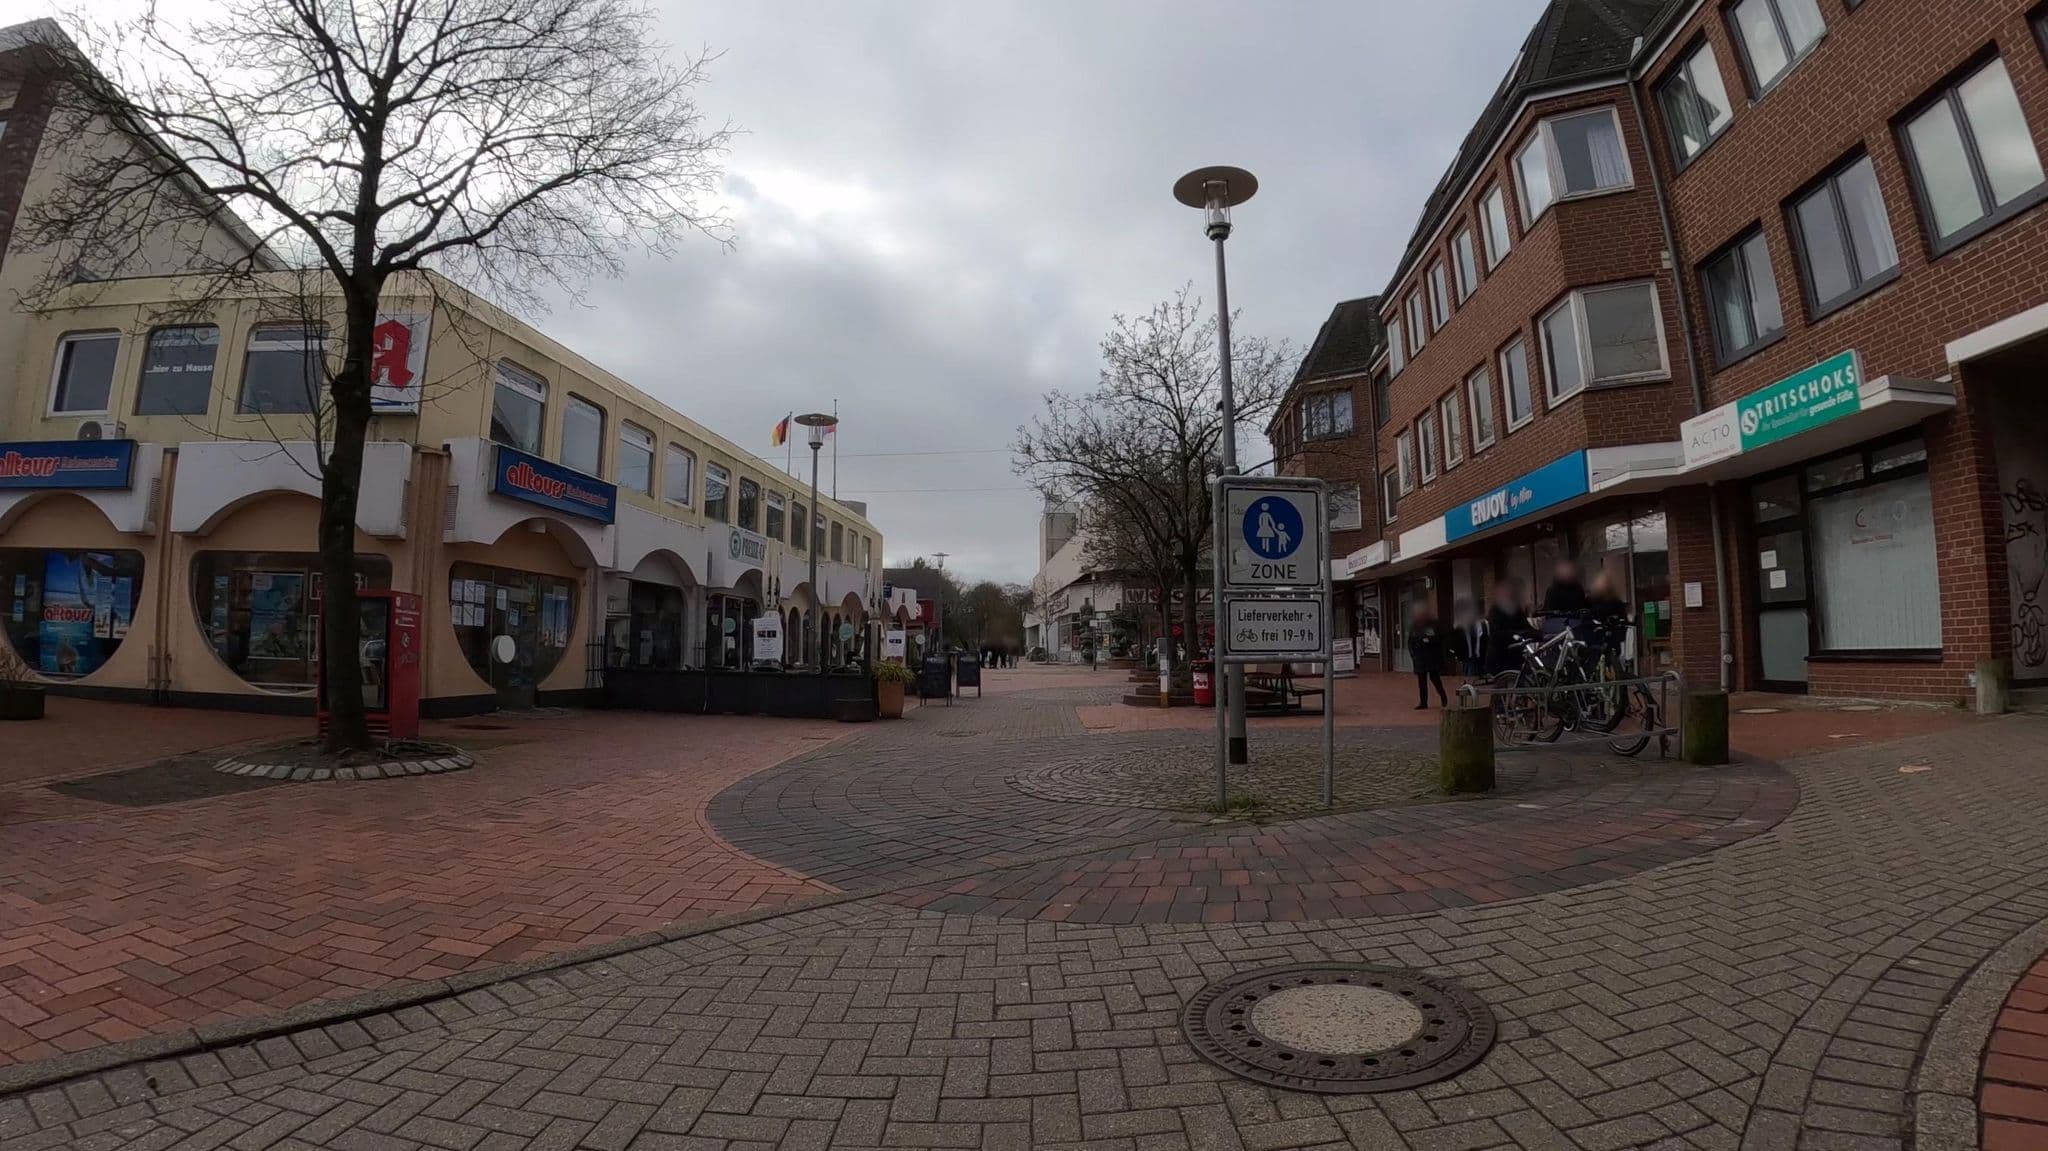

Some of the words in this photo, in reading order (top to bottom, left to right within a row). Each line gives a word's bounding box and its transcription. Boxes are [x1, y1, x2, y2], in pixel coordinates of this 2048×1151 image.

[185, 363, 213, 372] Hause
[1756, 365, 1855, 419] TRITSCHOKS
[1692, 424, 1730, 448] ACTO
[506, 461, 567, 500] alltours
[1251, 564, 1296, 579] ZONE
[1238, 609, 1303, 621] Lieferverkehr
[1262, 629, 1278, 641] frei
